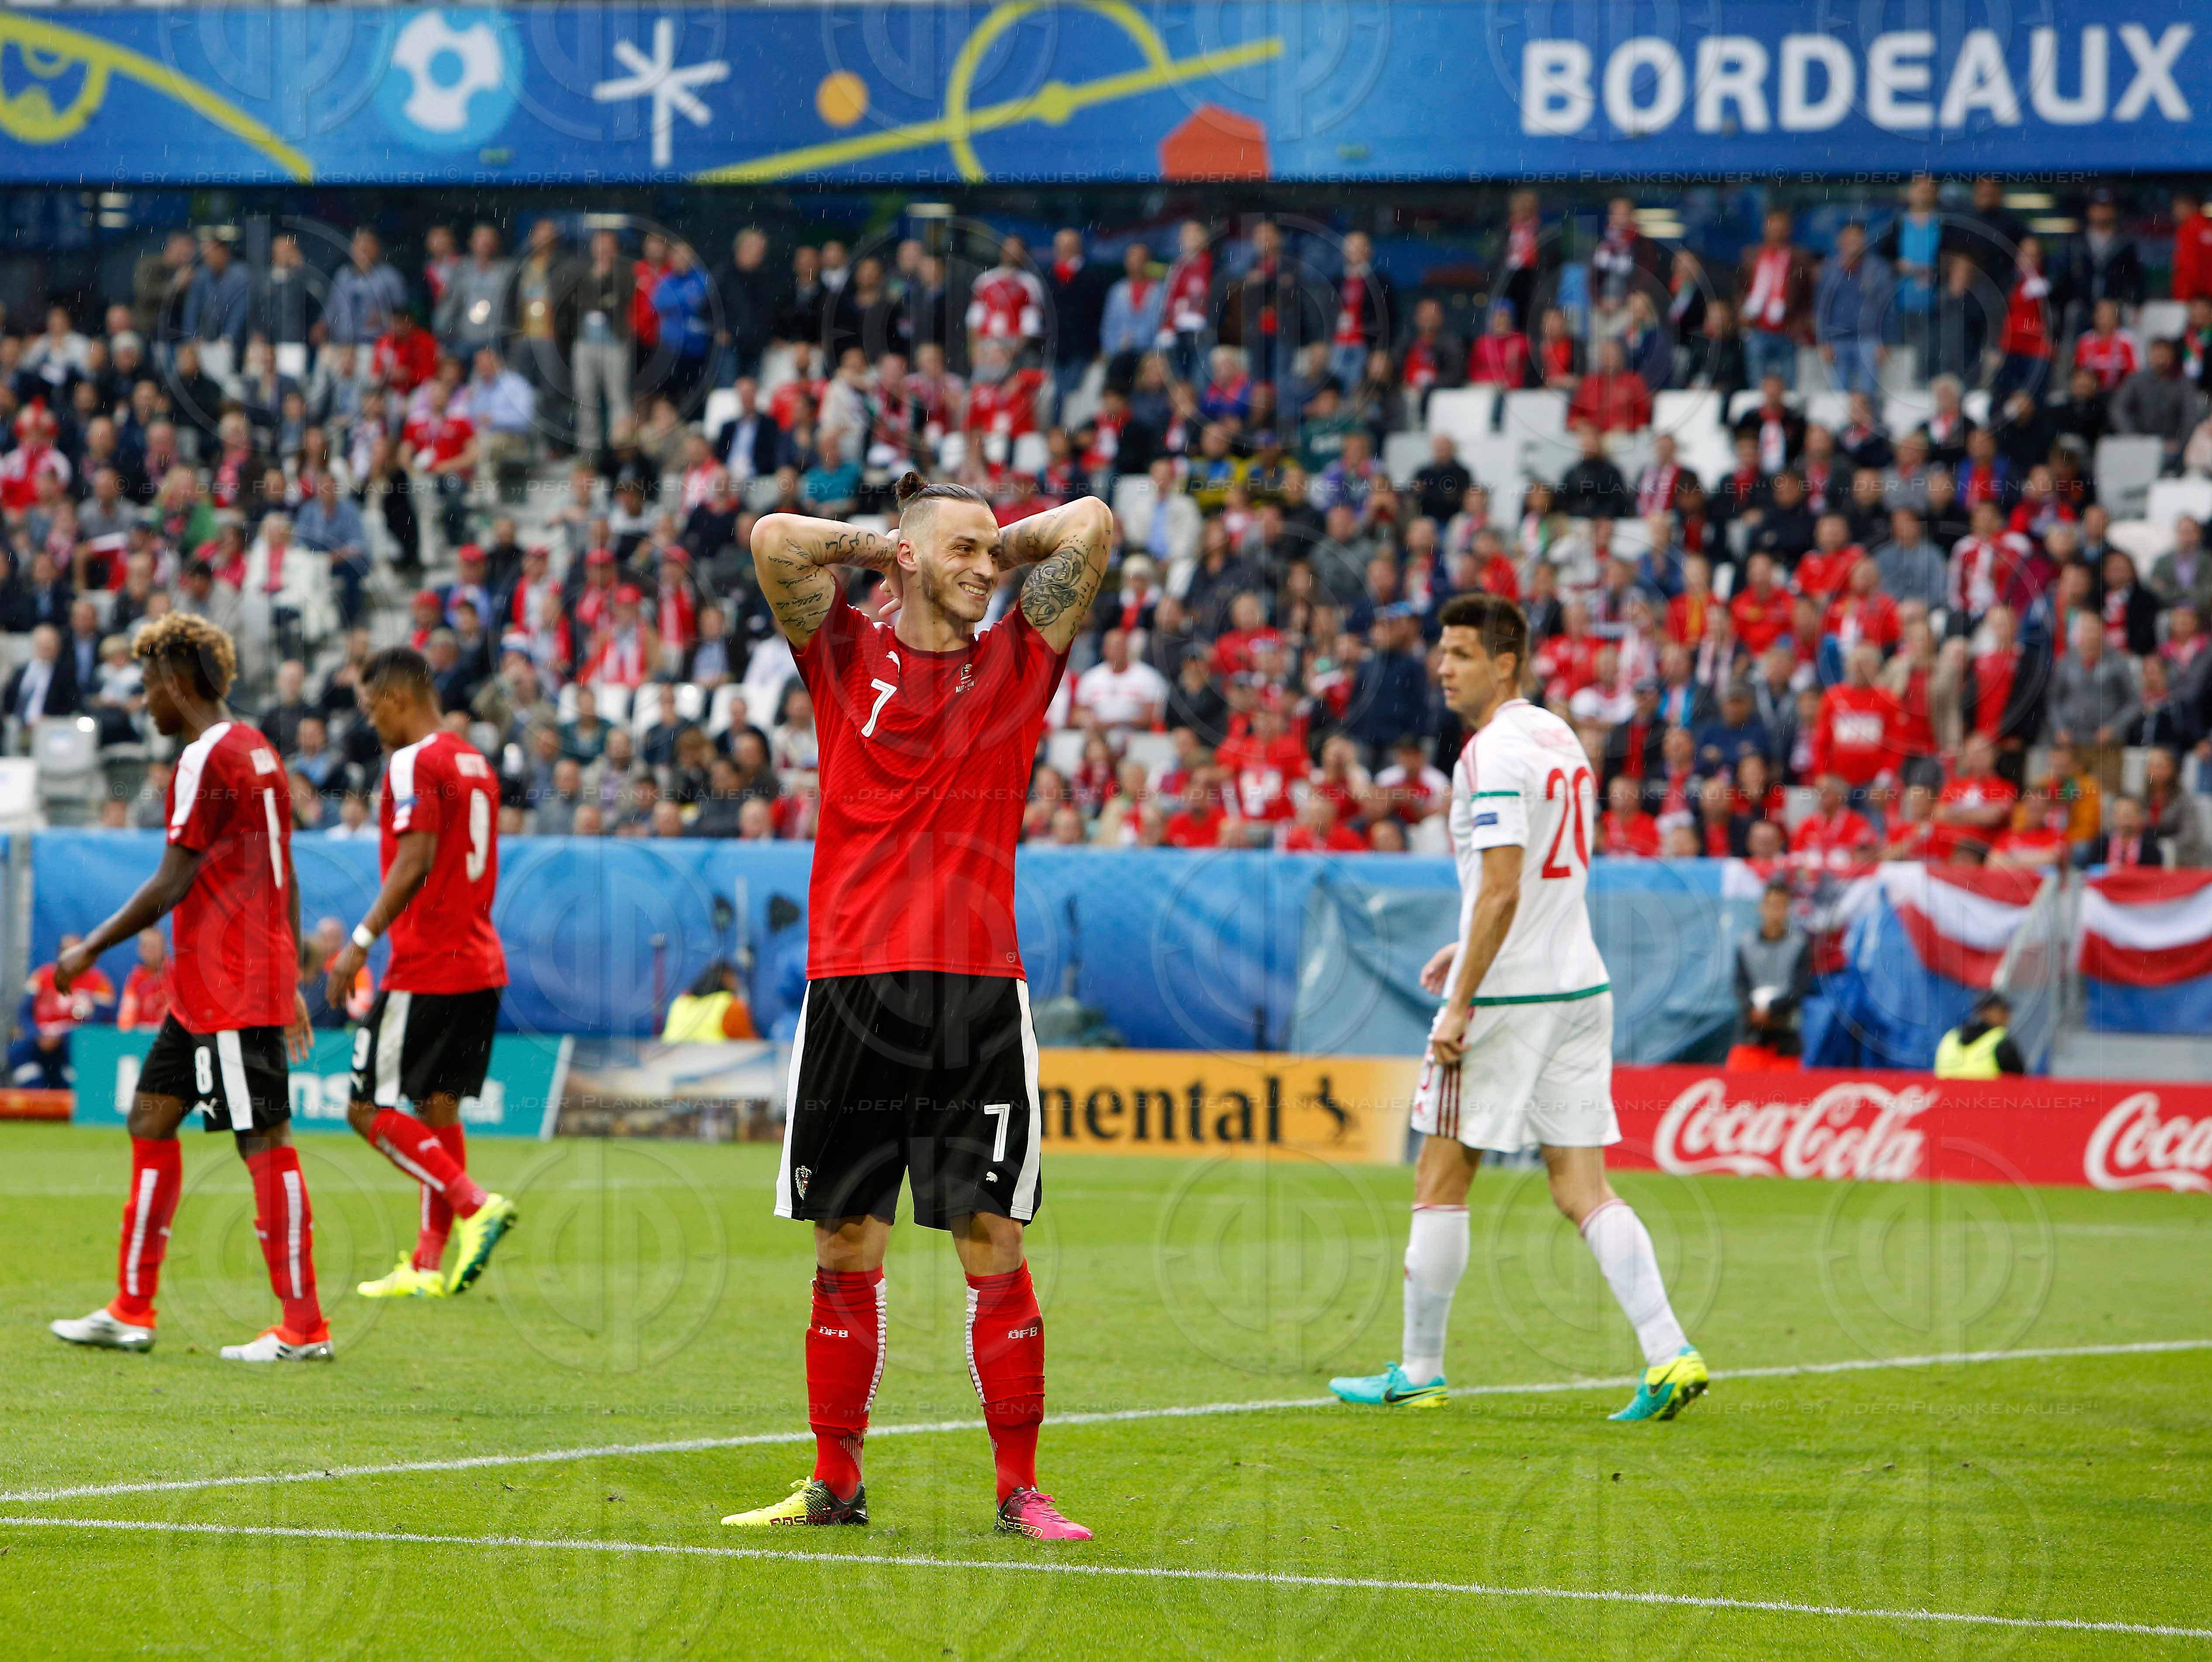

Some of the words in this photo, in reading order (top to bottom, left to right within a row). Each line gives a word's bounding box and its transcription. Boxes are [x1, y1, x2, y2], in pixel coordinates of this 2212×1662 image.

[1521, 23, 2194, 135] BORDEAUX
[861, 678, 898, 738] 7
[466, 788, 490, 883] 9
[1541, 767, 1597, 879] 20
[195, 1046, 213, 1094] 8
[984, 1104, 1010, 1162] 7
[1652, 1077, 1941, 1181] Coca-Cola
[819, 1326, 849, 1338] ÖFB
[1008, 1326, 1038, 1339] ÖFB
